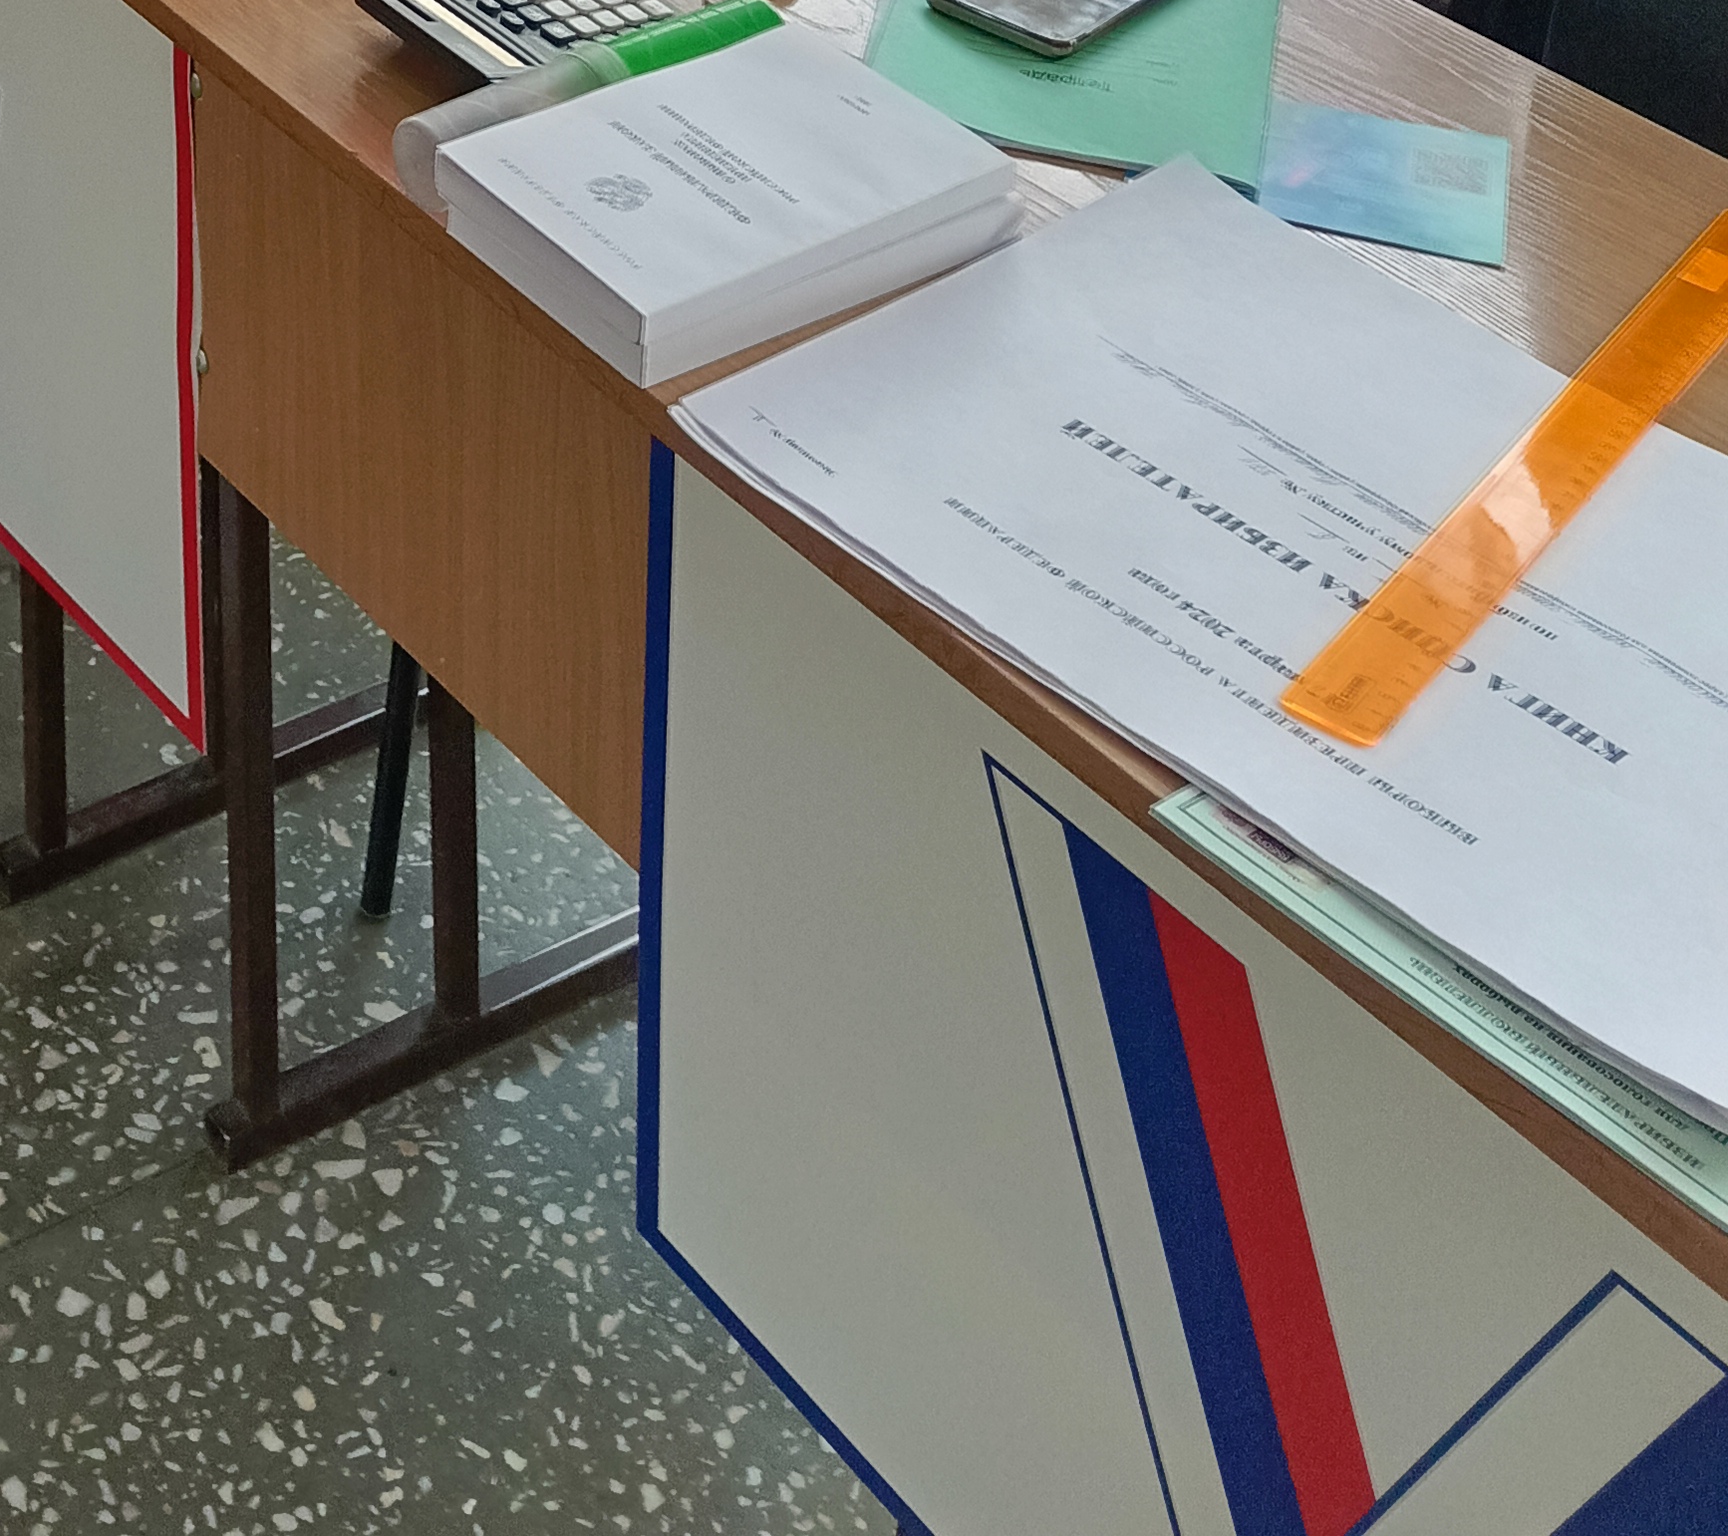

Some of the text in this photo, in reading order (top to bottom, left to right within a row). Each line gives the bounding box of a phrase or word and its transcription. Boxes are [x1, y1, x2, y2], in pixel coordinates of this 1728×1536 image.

[1061, 420, 1310, 571] ИЗБИРАТЕЛЕЙ
[1306, 493, 1380, 535] участку
[1127, 567, 1180, 601] года
[1175, 600, 1235, 638] 2024
[1324, 570, 1478, 675] СПИСКА
[1528, 622, 1558, 641] по
[943, 497, 1478, 845] ВЫБОРЫ ПРЕЗИДЕНТА РОССИЙСКОЙ ФЕДЕРАЦИИ
[1233, 636, 1297, 681] марта
[1487, 674, 1627, 763] КНИГА
[1410, 956, 1529, 1043] БЮЛЛЕТЕНЬ
[1452, 962, 1524, 1014] выборах
[1521, 1010, 1546, 1031] на
[1546, 1029, 1652, 1106] голосования
[1525, 1037, 1704, 1168] ИЗБИРАТЕЛЬНЫЙ
[1653, 1102, 1690, 1132] для
